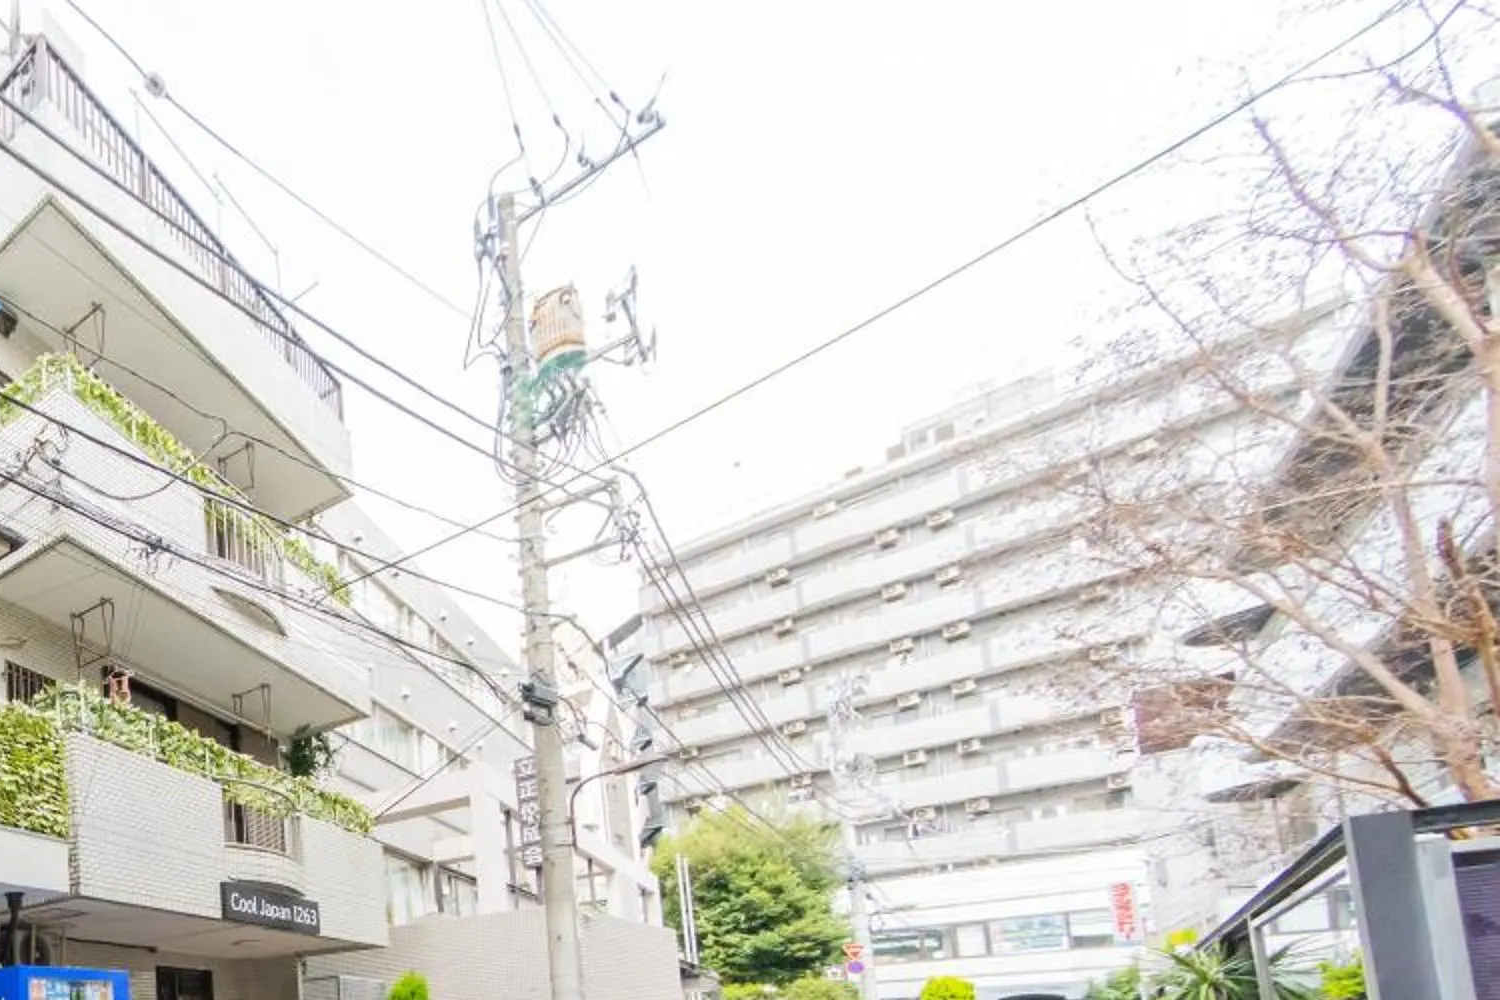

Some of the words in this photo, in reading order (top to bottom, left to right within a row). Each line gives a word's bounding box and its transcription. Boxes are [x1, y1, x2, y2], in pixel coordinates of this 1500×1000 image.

[231, 893, 258, 916] Cool
[260, 899, 291, 920] Japan
[294, 905, 317, 926] 1263
